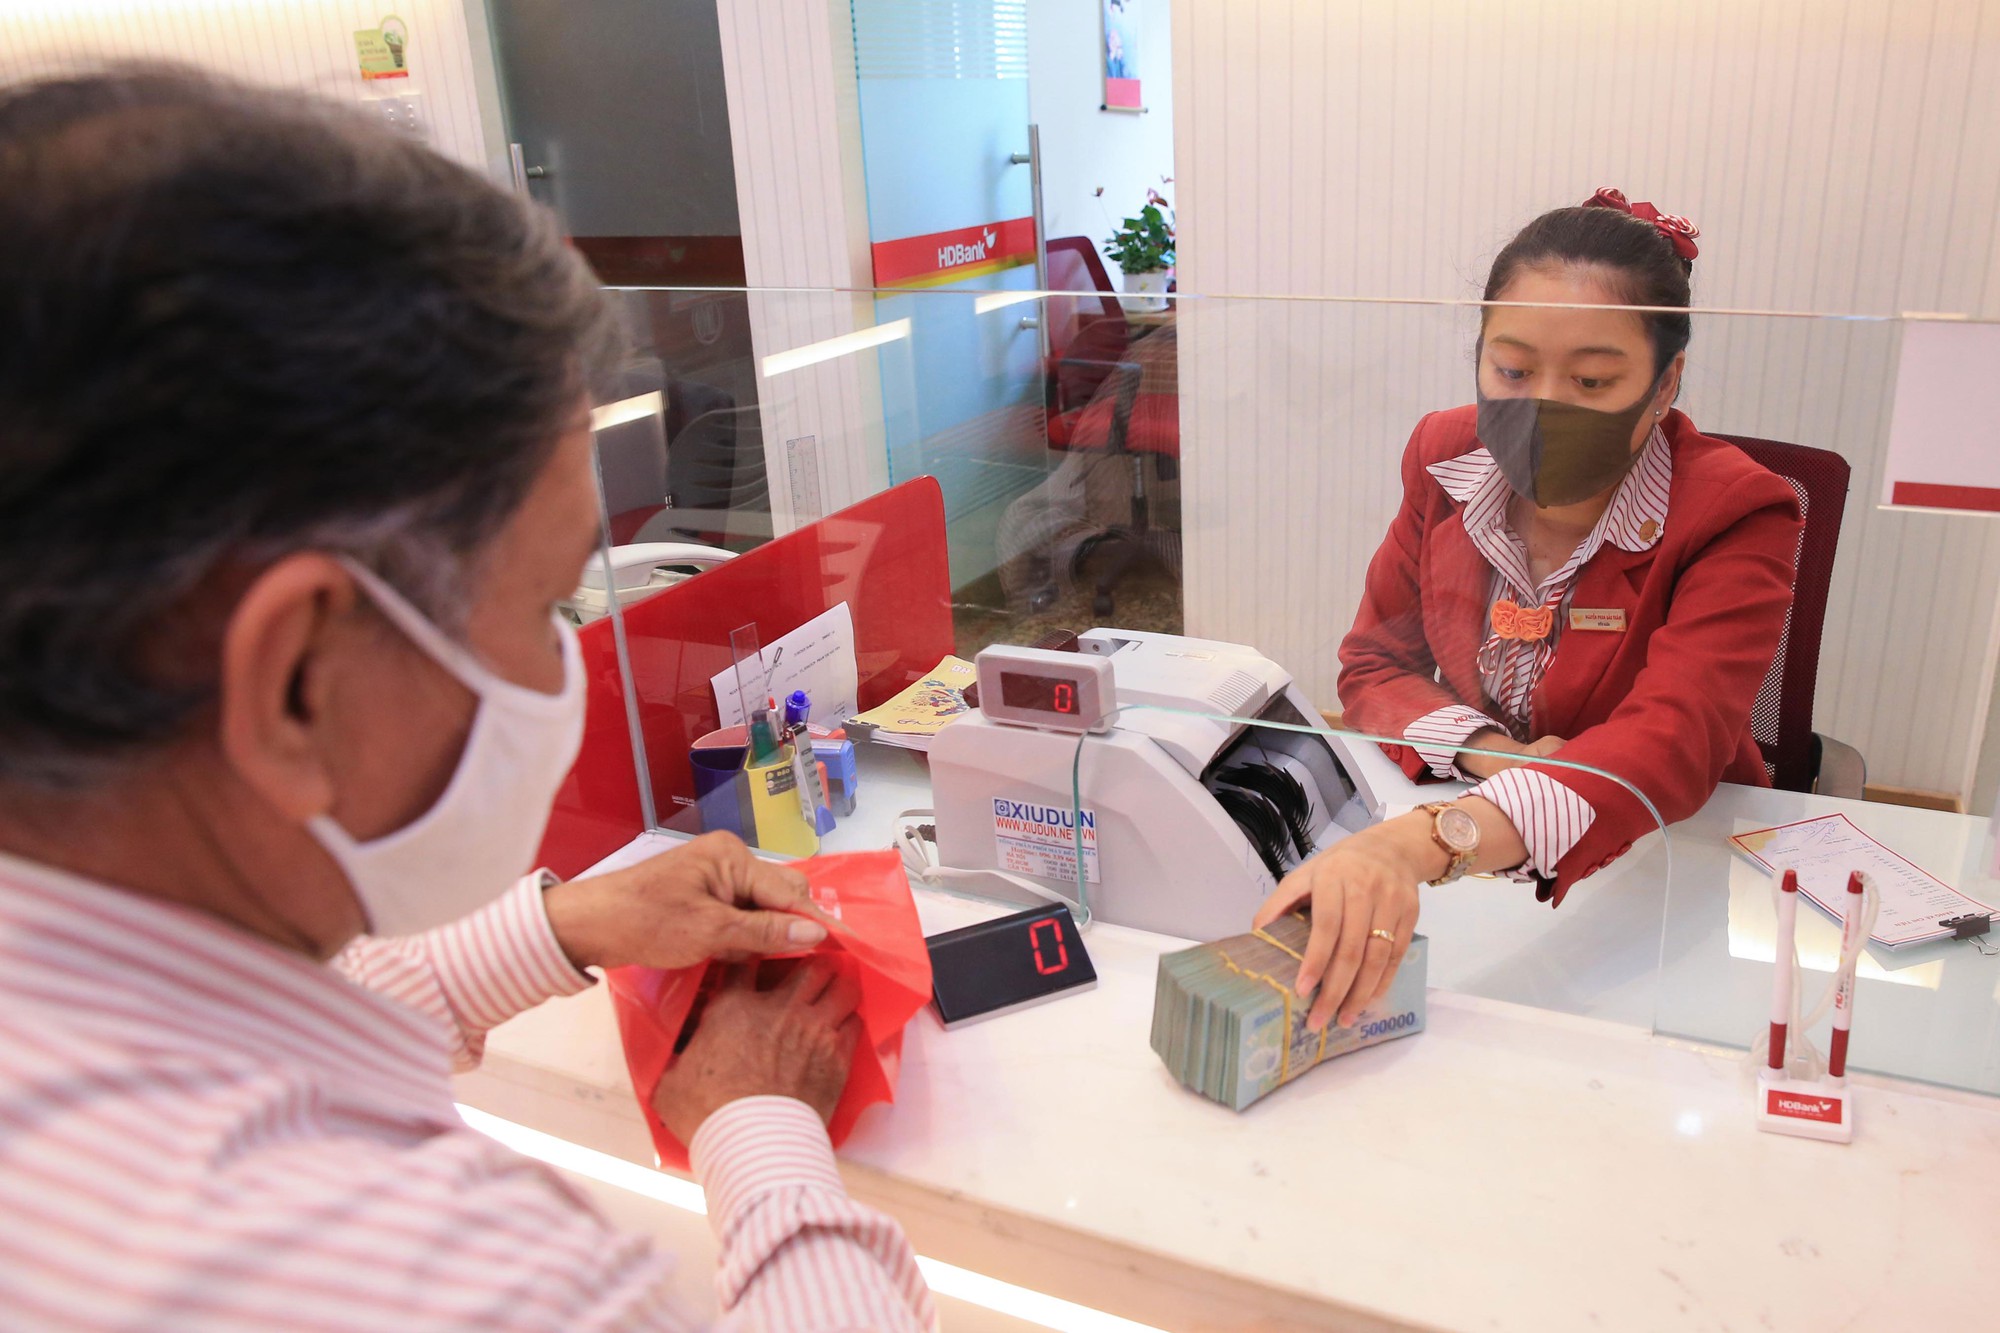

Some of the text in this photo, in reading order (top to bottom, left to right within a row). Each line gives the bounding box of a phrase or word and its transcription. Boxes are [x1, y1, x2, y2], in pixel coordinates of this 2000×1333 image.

[938, 240, 986, 268] HDBank
[1054, 684, 1072, 713] 0
[996, 817, 1095, 840] WWW.XIUDUN.NEVN
[1011, 802, 1094, 828] XIUDUN
[1029, 917, 1069, 975] 0
[1360, 1011, 1415, 1040] 500000
[1779, 1100, 1820, 1113] HDBank
